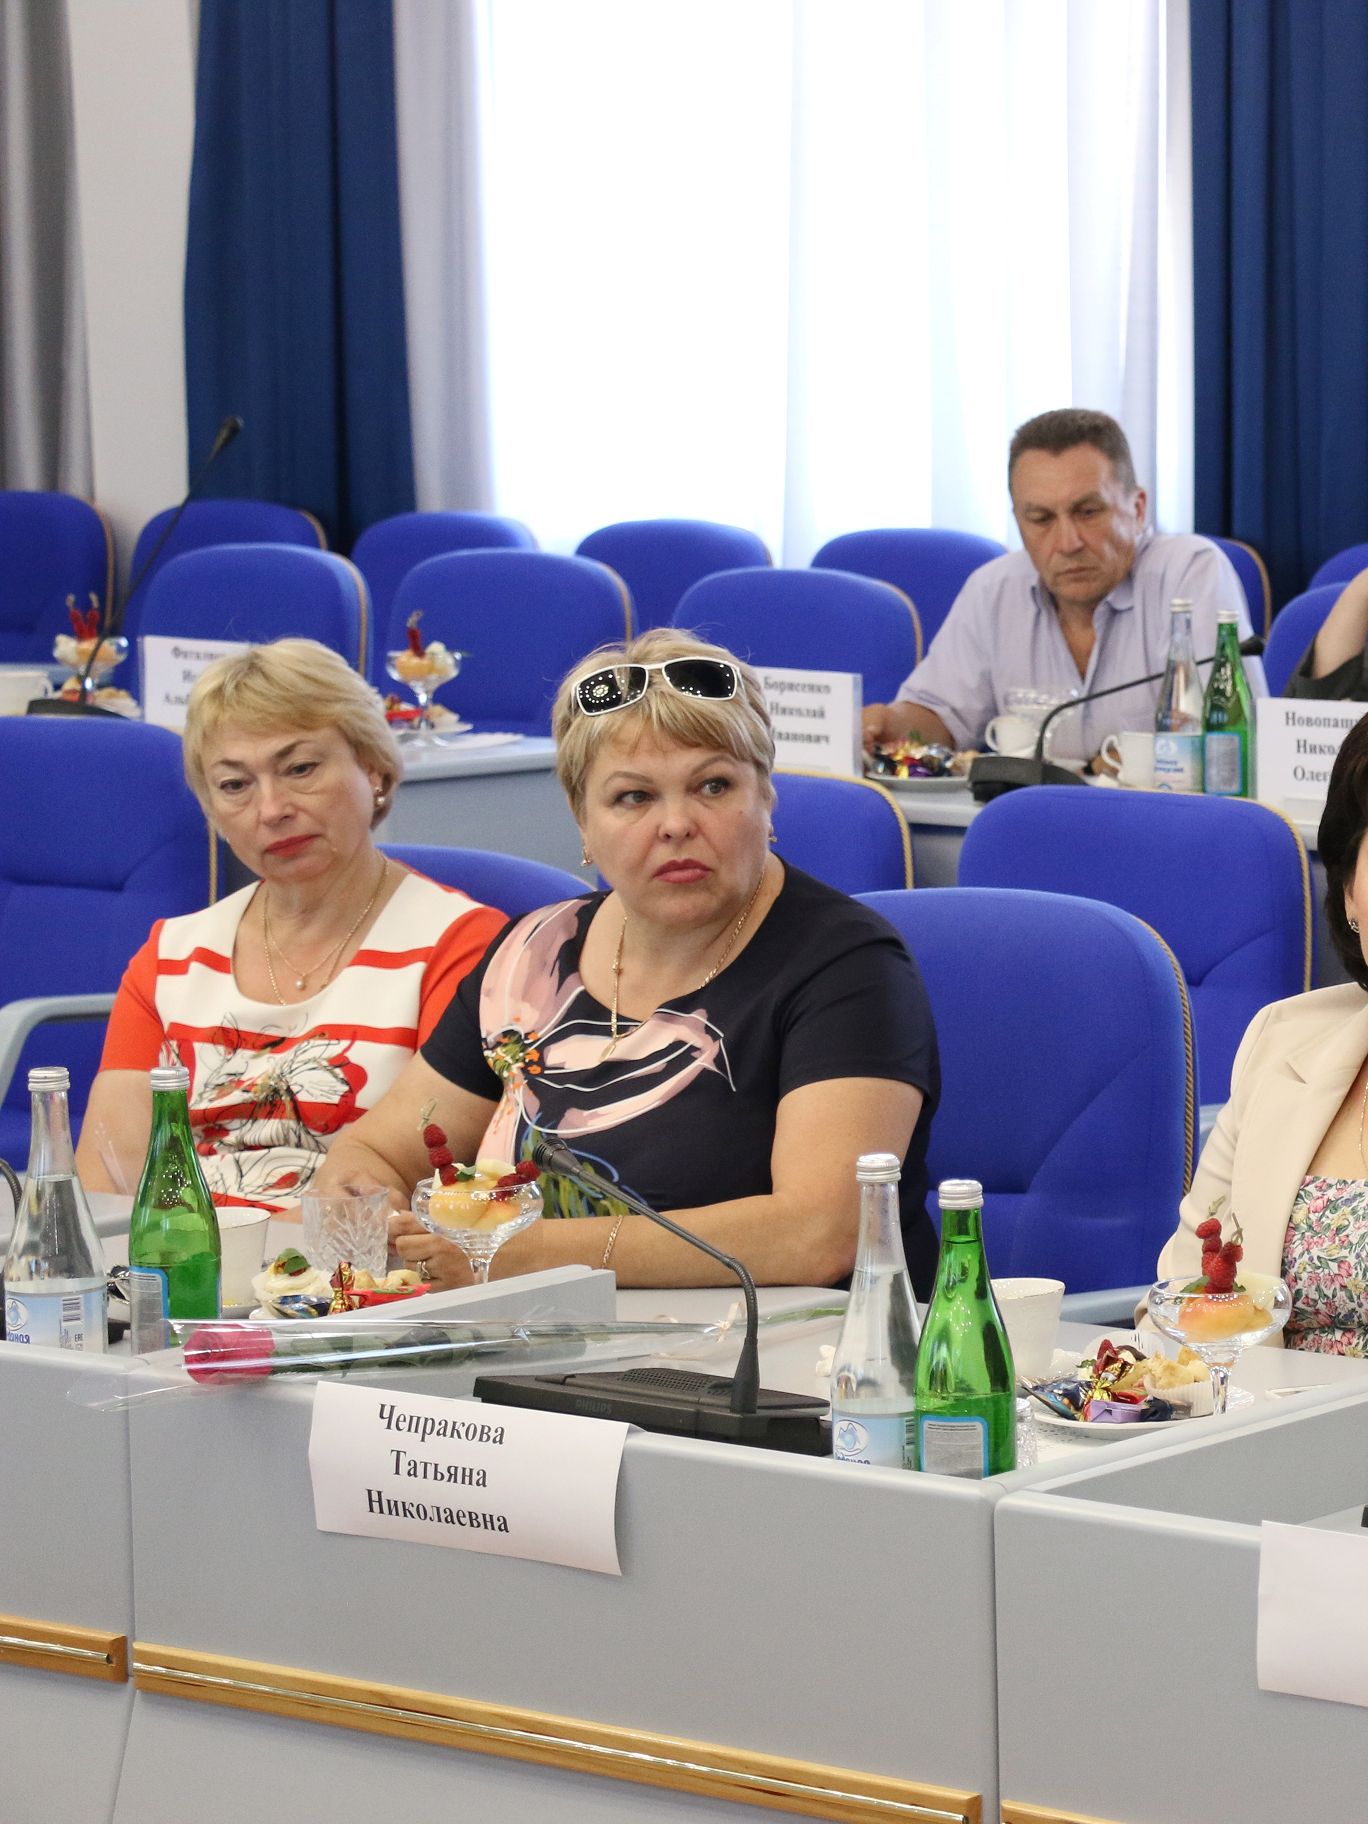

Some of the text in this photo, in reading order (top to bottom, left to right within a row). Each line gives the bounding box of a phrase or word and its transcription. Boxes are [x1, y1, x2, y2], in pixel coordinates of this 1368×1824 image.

[763, 676, 831, 695] Борисенко
[769, 702, 826, 719] Николай
[1296, 739, 1339, 755] Нико
[1293, 766, 1329, 782] Олег
[379, 1403, 506, 1445] Чепракова
[390, 1449, 488, 1488] Татьяна
[365, 1487, 510, 1533] Николаевна
